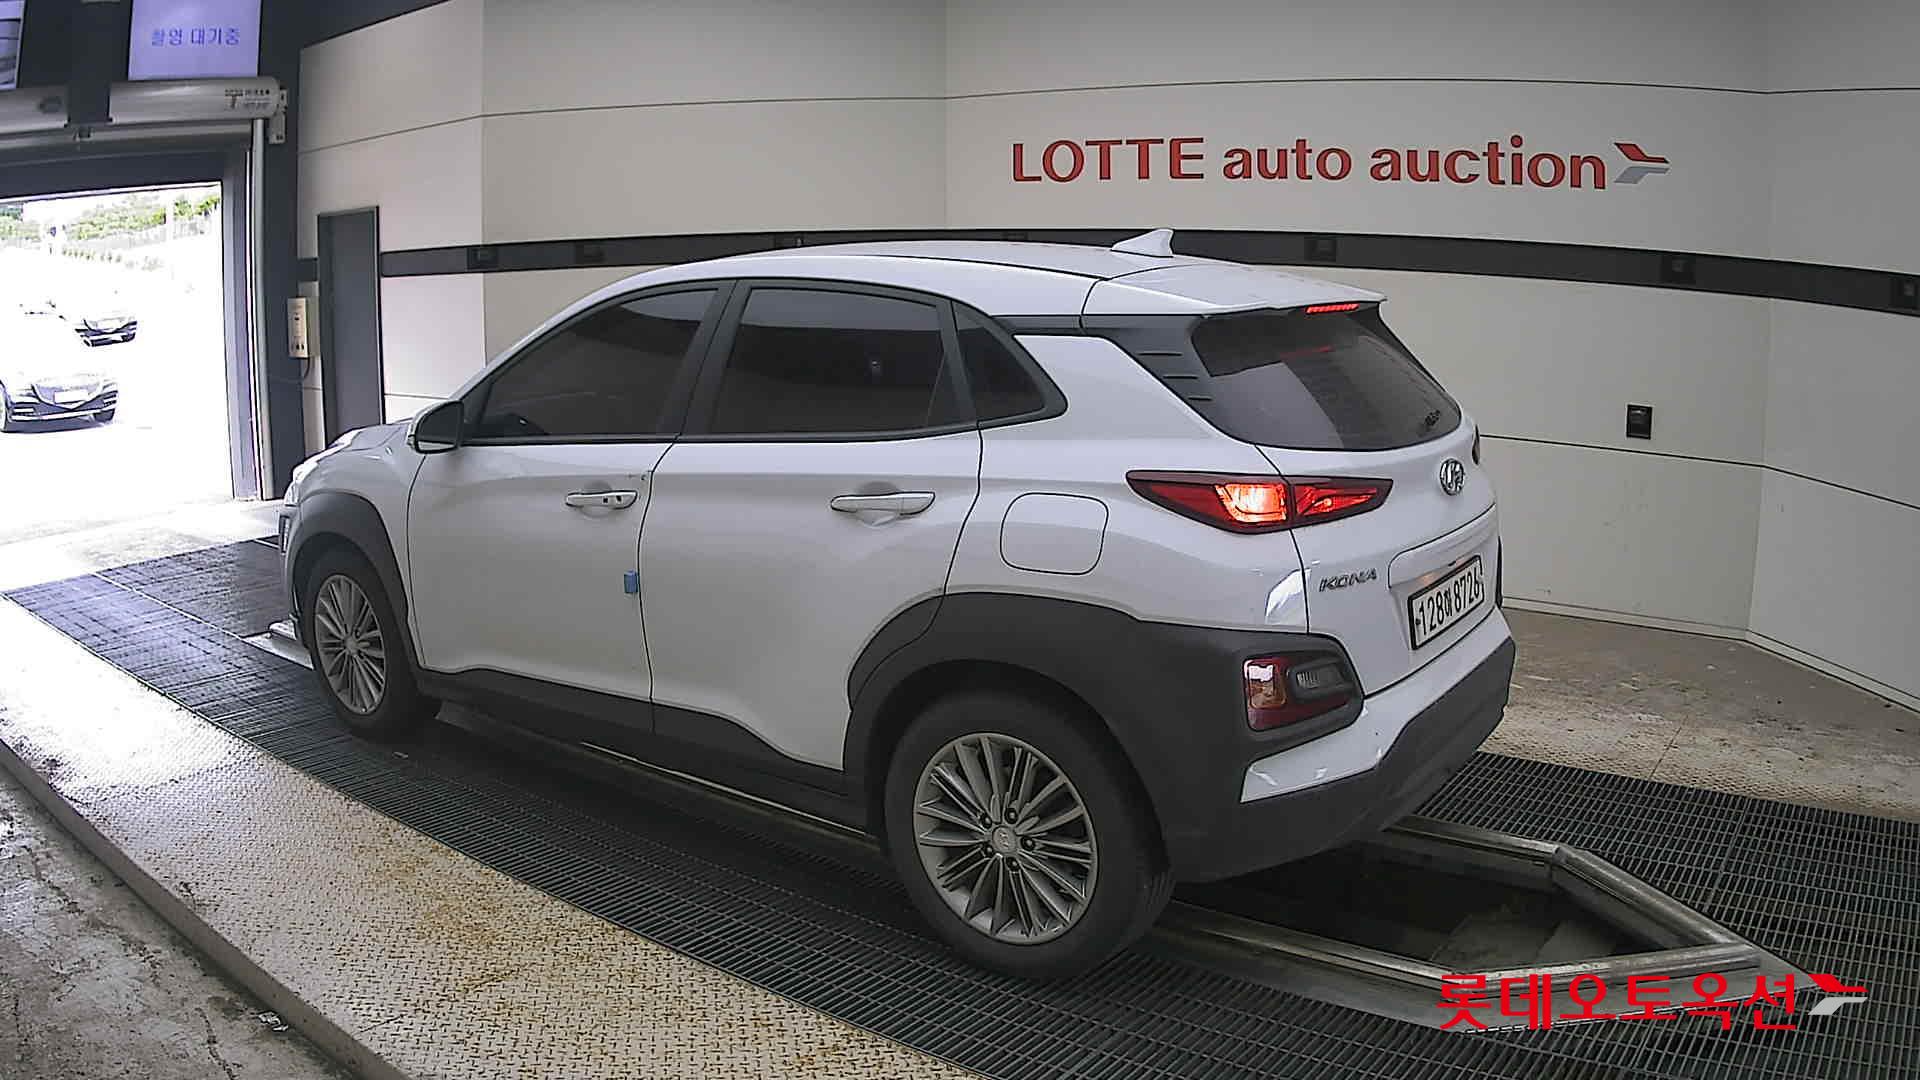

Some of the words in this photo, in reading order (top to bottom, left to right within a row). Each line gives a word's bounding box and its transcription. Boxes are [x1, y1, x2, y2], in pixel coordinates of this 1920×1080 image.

[191, 28, 240, 46] 대기중
[1014, 138, 1204, 182] LOTTE
[1223, 140, 1354, 181] auto
[1370, 134, 1608, 190] auction
[1319, 568, 1377, 592] KONA
